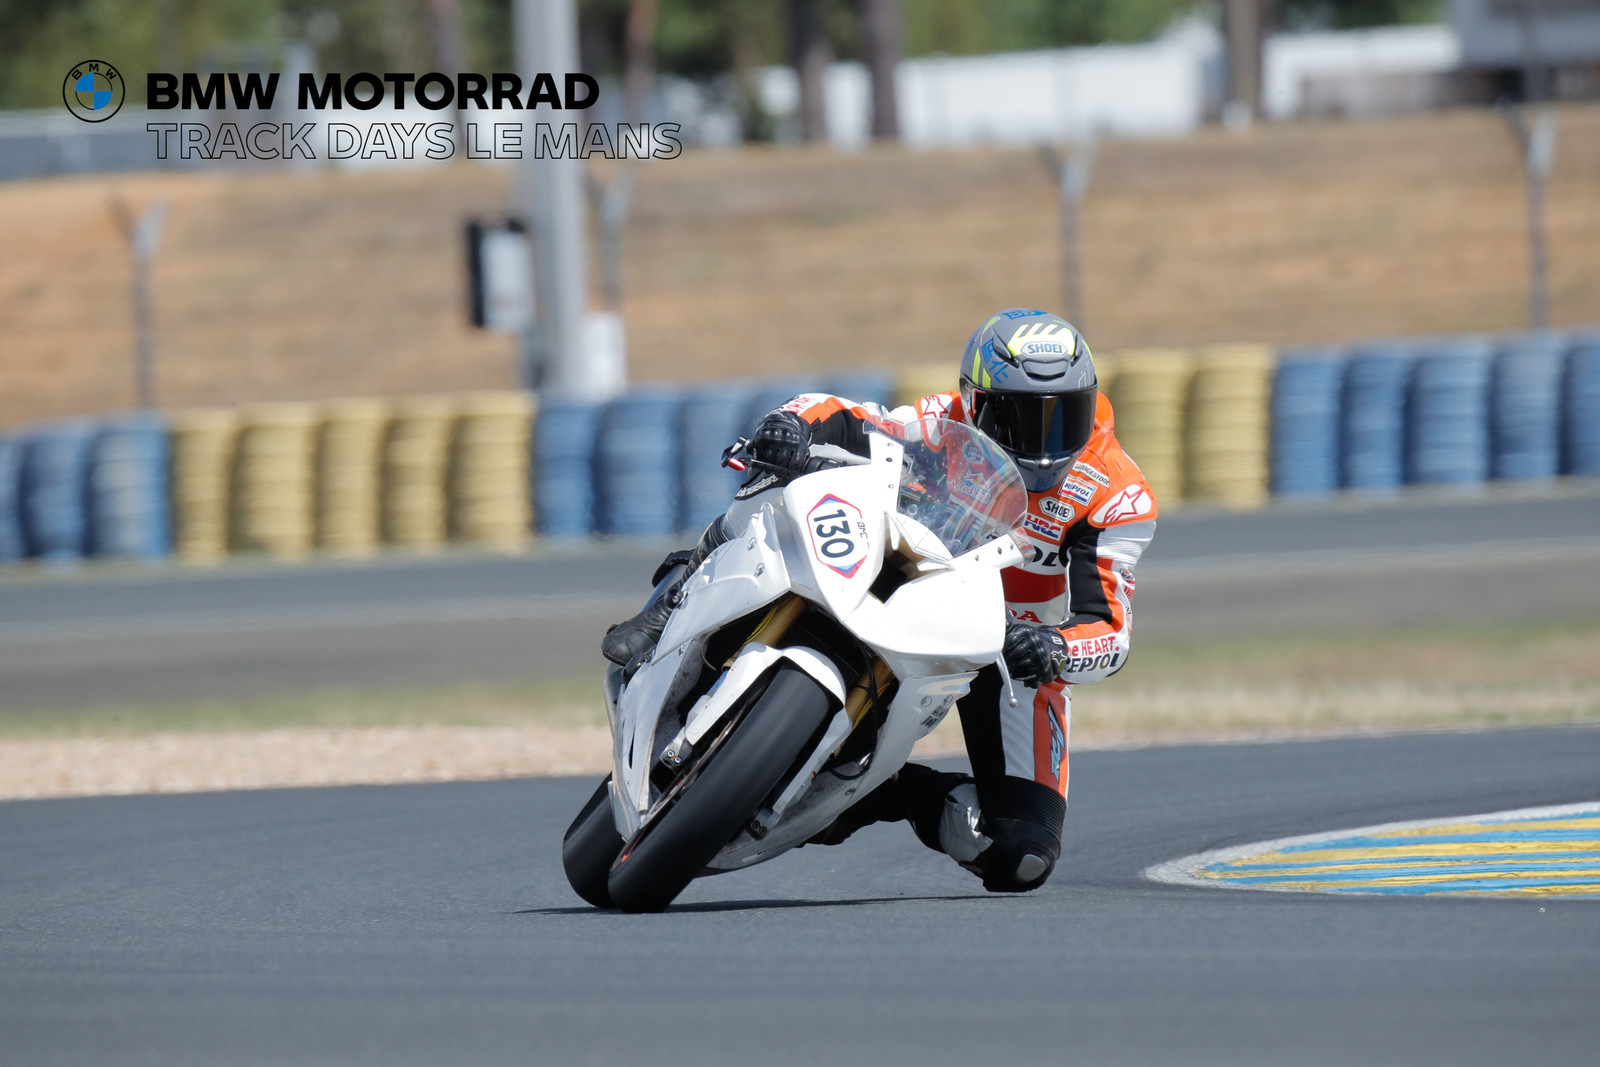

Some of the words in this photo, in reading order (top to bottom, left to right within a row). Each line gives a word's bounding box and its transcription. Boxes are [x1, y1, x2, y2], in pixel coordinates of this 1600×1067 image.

[1027, 343, 1063, 354] SHOEI
[813, 509, 855, 558] 130
[1024, 514, 1062, 539] HRC
